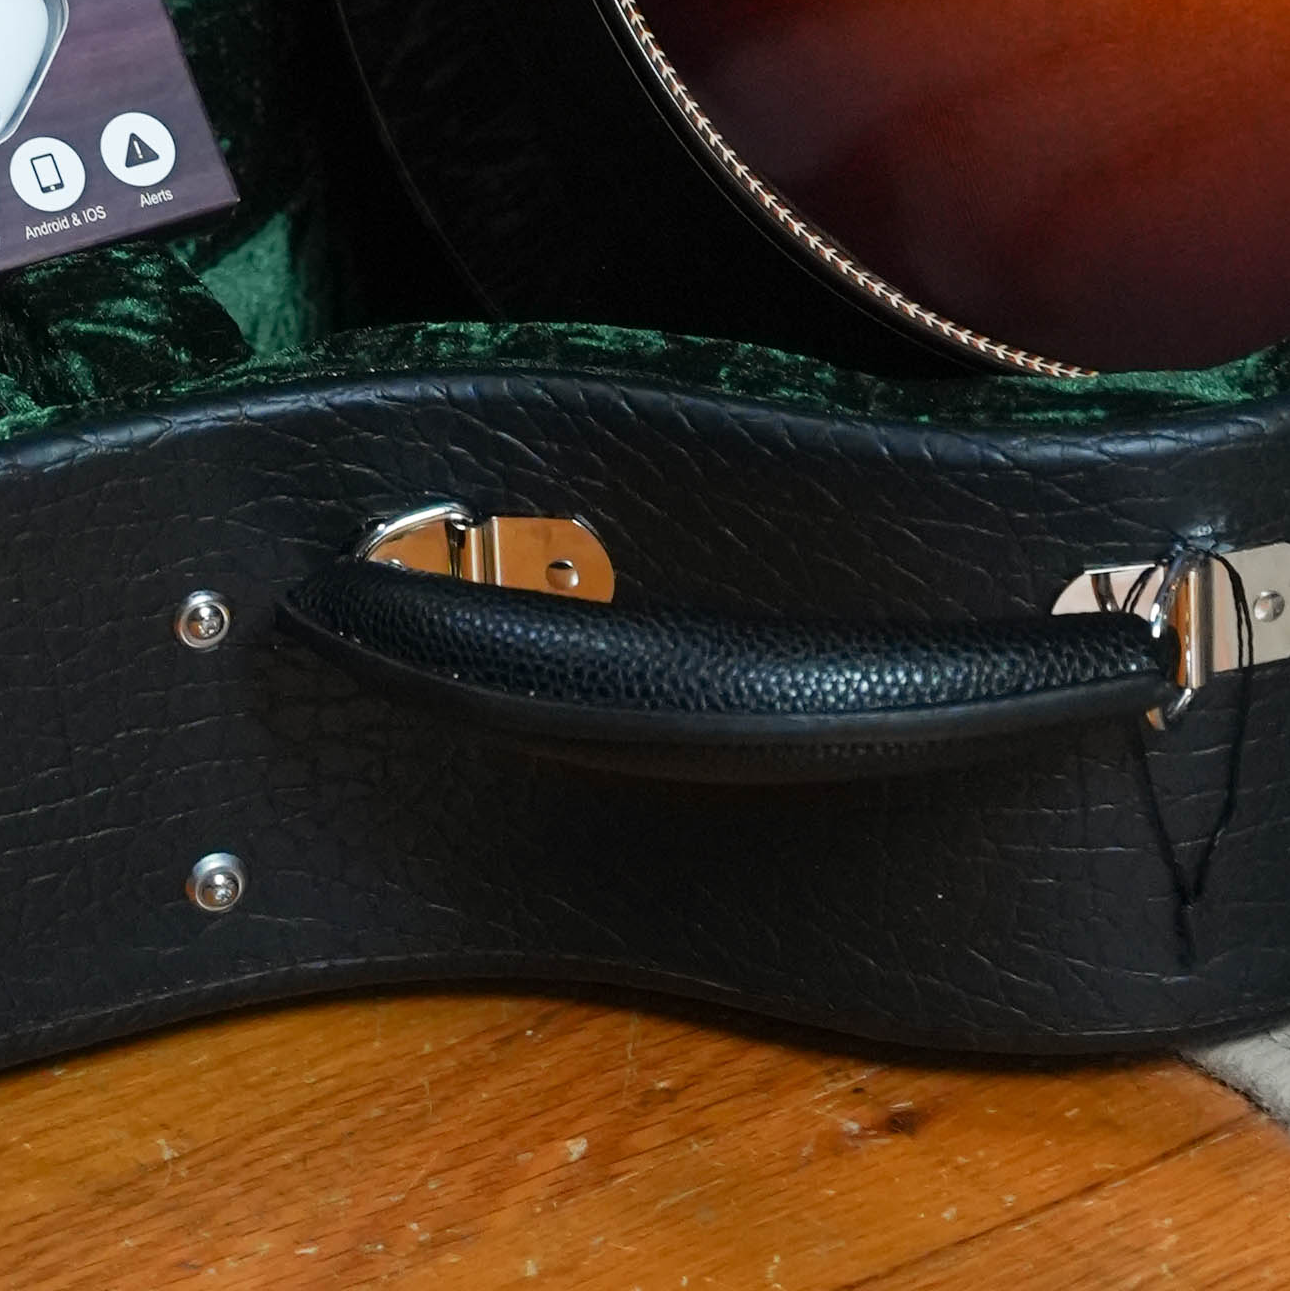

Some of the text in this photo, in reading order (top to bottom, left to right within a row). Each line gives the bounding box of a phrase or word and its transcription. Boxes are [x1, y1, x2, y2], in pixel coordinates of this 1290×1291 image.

[139, 188, 174, 208] Alerts
[25, 205, 108, 240] Android & IOS
